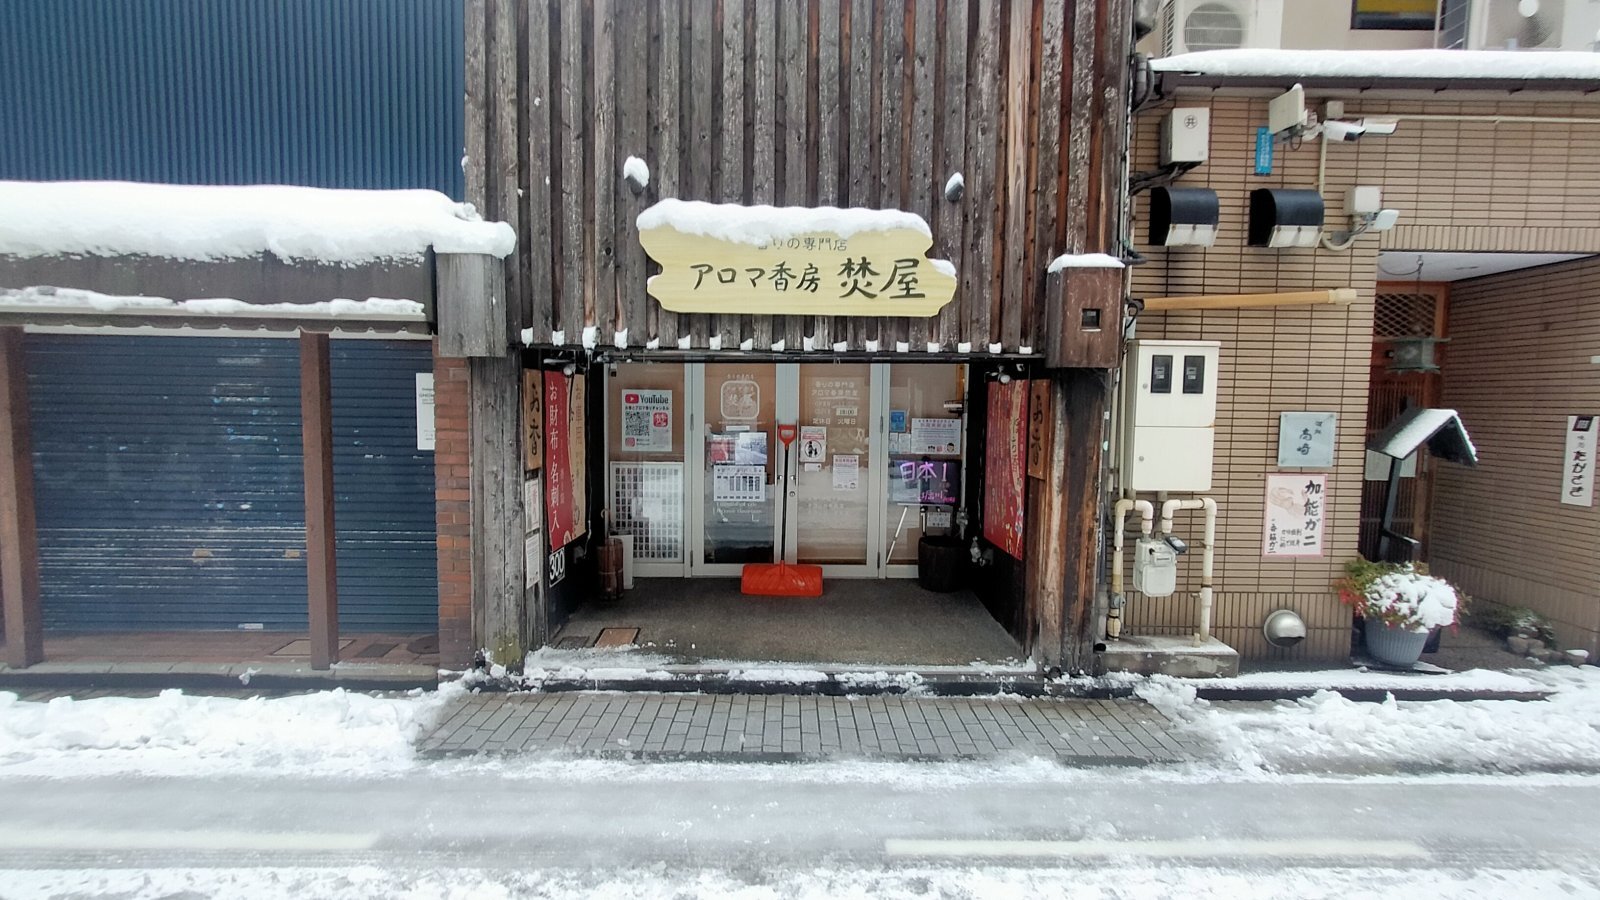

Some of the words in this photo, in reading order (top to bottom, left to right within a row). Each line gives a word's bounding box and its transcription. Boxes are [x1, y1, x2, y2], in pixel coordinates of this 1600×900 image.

[757, 238, 848, 252] りの専門店
[690, 261, 821, 293] アロマ香房
[837, 256, 925, 299] 焚屋
[640, 394, 669, 404] YouTube
[1303, 480, 1322, 547] 加能ガニ
